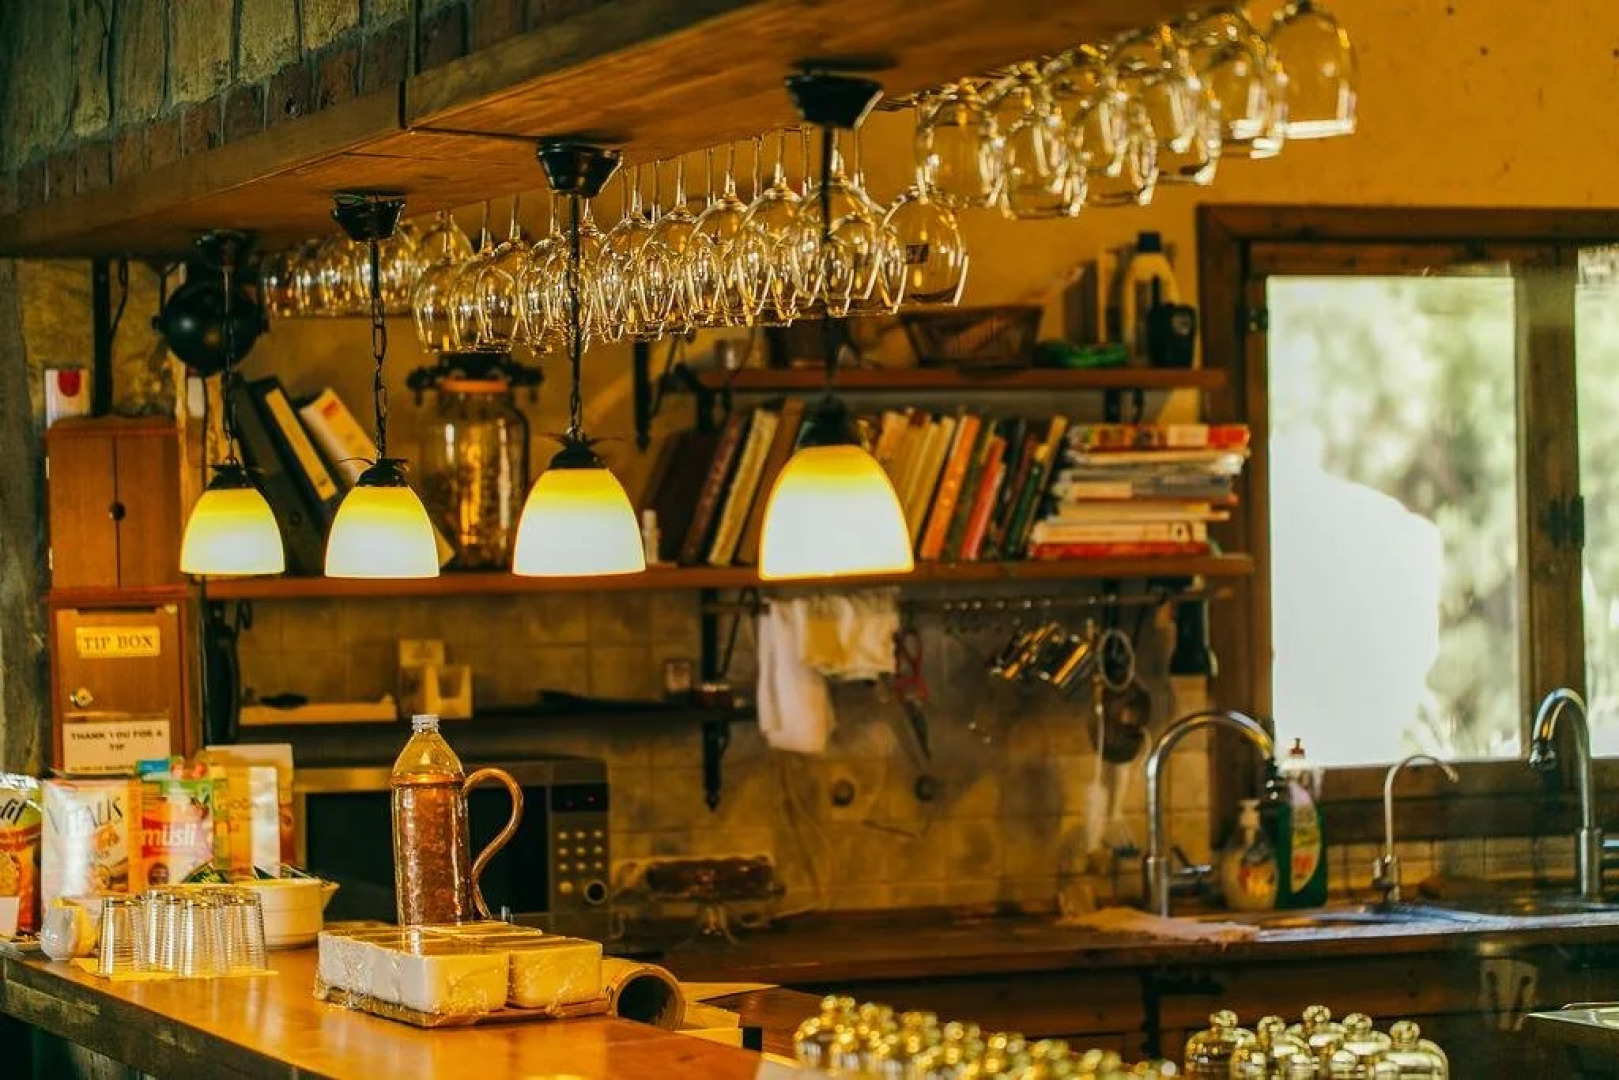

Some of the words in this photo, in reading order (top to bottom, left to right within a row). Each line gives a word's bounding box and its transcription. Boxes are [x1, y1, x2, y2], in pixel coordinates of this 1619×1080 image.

[83, 635, 111, 651] TIP
[116, 633, 153, 649] BOX
[71, 732, 105, 741] THANK
[109, 731, 130, 739] YOU
[133, 729, 152, 738] FOR
[156, 729, 163, 737] A
[109, 743, 125, 751] TIP
